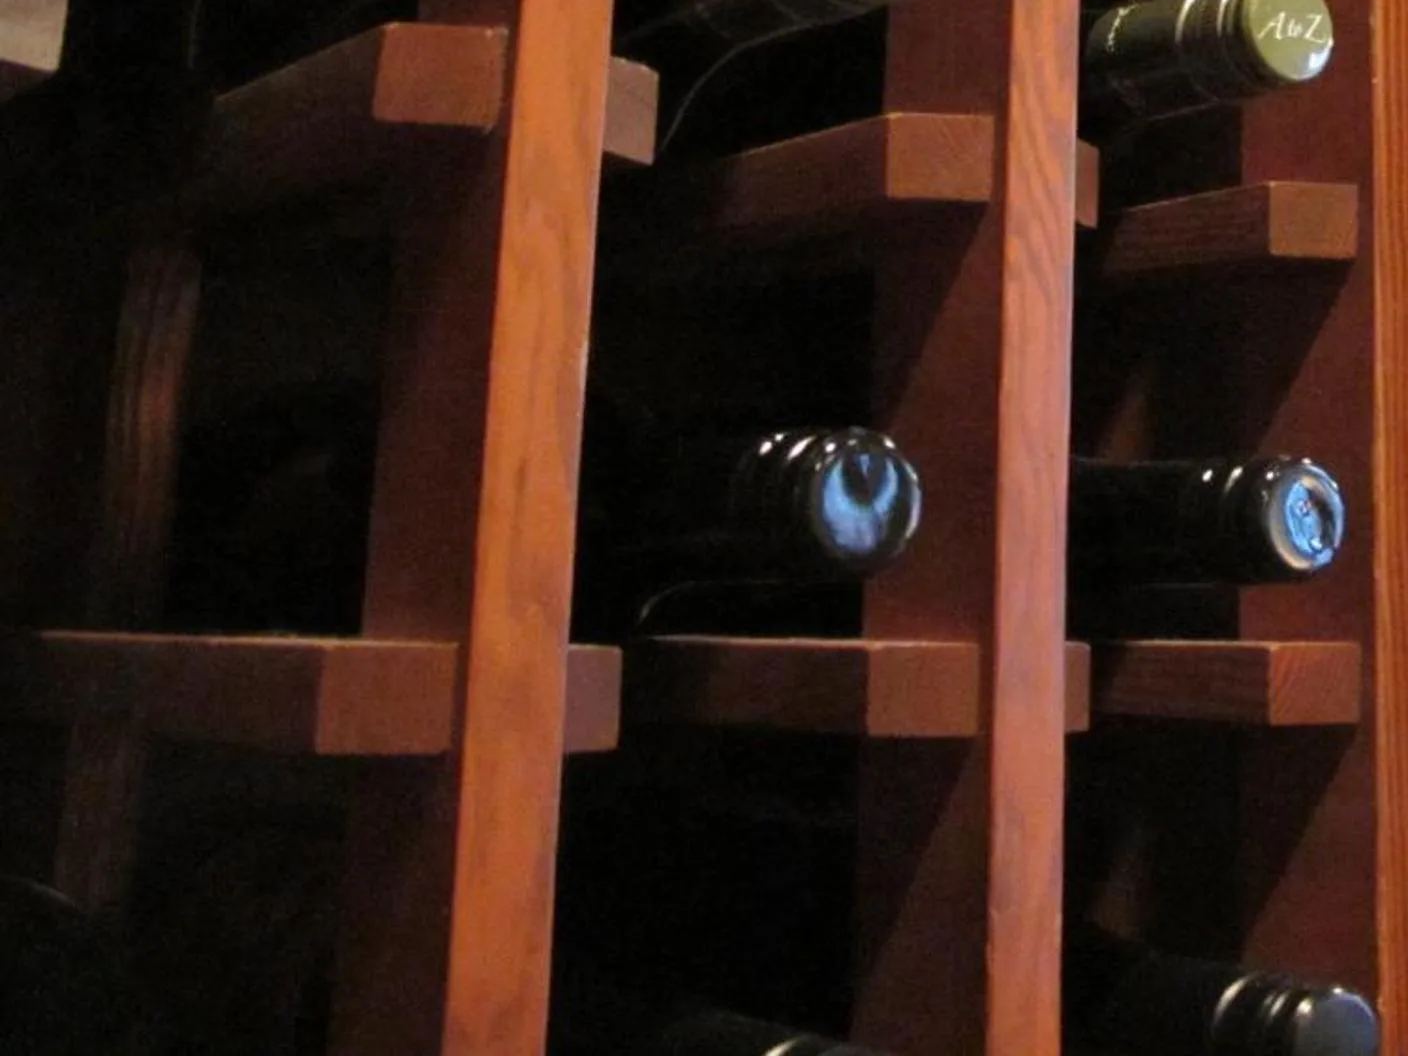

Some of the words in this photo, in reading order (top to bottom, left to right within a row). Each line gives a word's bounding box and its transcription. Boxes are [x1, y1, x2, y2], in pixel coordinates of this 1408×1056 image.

[1258, 11, 1287, 40] A
[1286, 19, 1302, 38] to
[1305, 14, 1329, 44] Z
